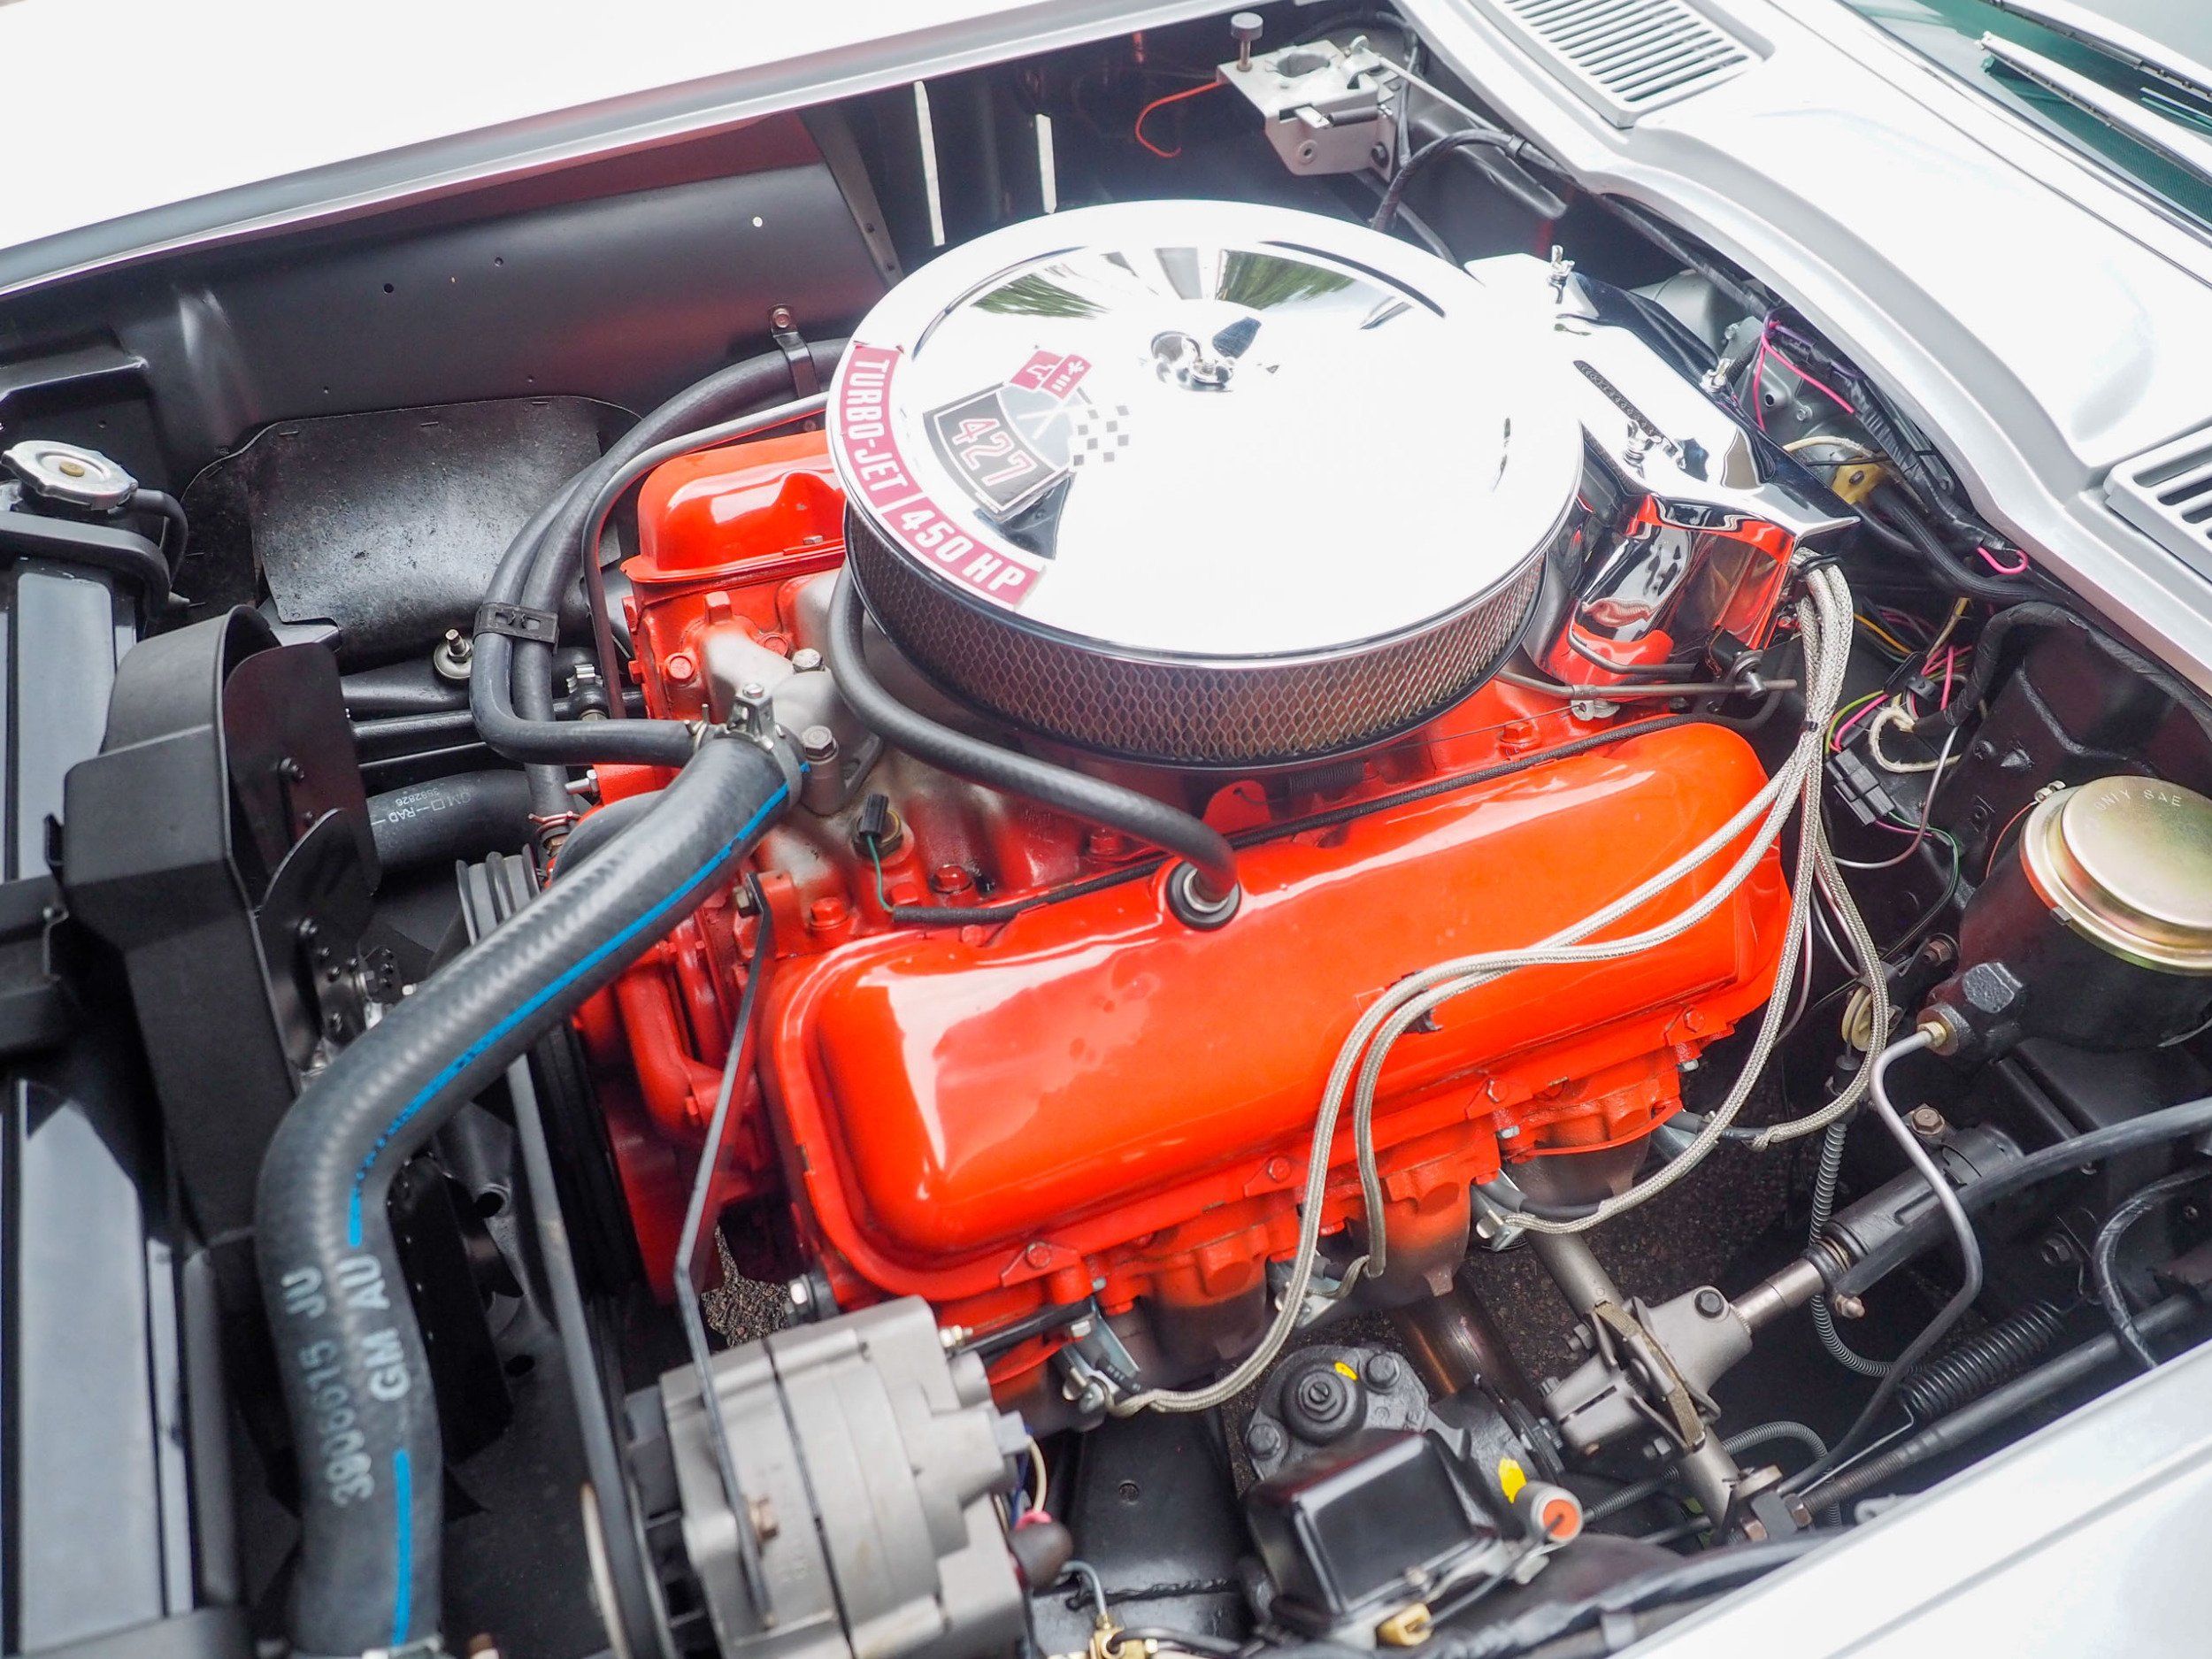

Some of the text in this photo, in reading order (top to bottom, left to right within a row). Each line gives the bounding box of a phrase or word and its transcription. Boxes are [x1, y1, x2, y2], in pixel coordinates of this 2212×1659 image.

[846, 358, 1027, 592] TURBO-JET 450 HP
[951, 416, 1040, 488] 427
[2143, 789, 2182, 808] SAE
[280, 1265, 328, 1319] JU
[335, 1255, 411, 1402] GM AU
